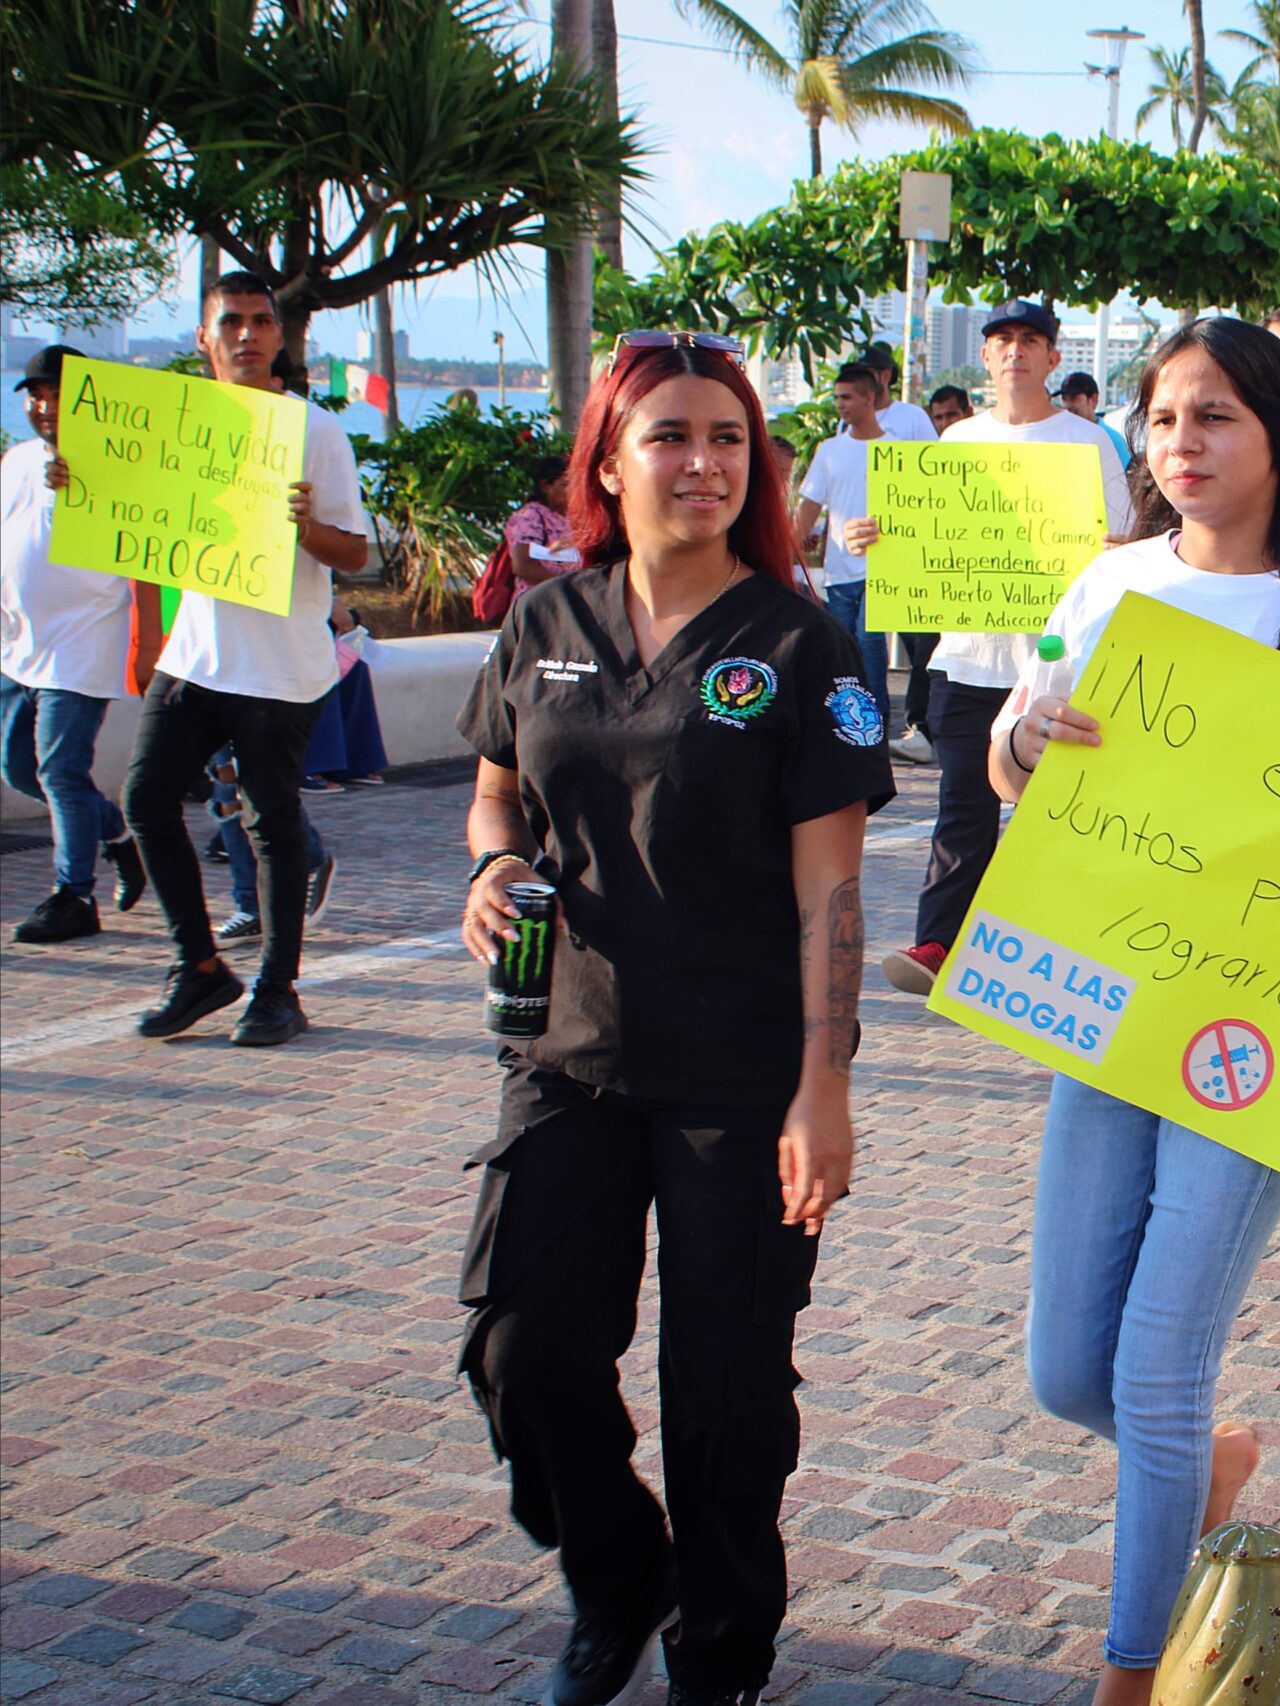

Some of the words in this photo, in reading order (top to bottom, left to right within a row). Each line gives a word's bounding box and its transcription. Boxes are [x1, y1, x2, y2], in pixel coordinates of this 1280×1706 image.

[71, 373, 151, 433] Ama
[176, 383, 213, 451] tu
[227, 406, 289, 476] vida
[104, 437, 143, 464] NO
[159, 439, 181, 472] la
[873, 445, 904, 474] Mi
[917, 444, 989, 487] Grupo
[1000, 449, 1022, 474] de
[64, 473, 95, 515] Di
[111, 499, 144, 524] no
[153, 507, 170, 528] a
[187, 491, 220, 538] las
[886, 483, 947, 511] Puerto
[958, 485, 1044, 514] Vallarta
[933, 516, 968, 541] Luz
[980, 525, 1005, 541] en
[1015, 519, 1033, 543] el
[908, 586, 929, 600] un
[941, 579, 993, 604] Puerto
[907, 605, 945, 627] libre
[956, 610, 973, 627] de
[1047, 769, 1204, 874] Juntos
[969, 921, 1024, 964] NO
[1027, 951, 1055, 982] A
[1062, 964, 1128, 1013] LAS
[956, 966, 1102, 1053] DROGAS
